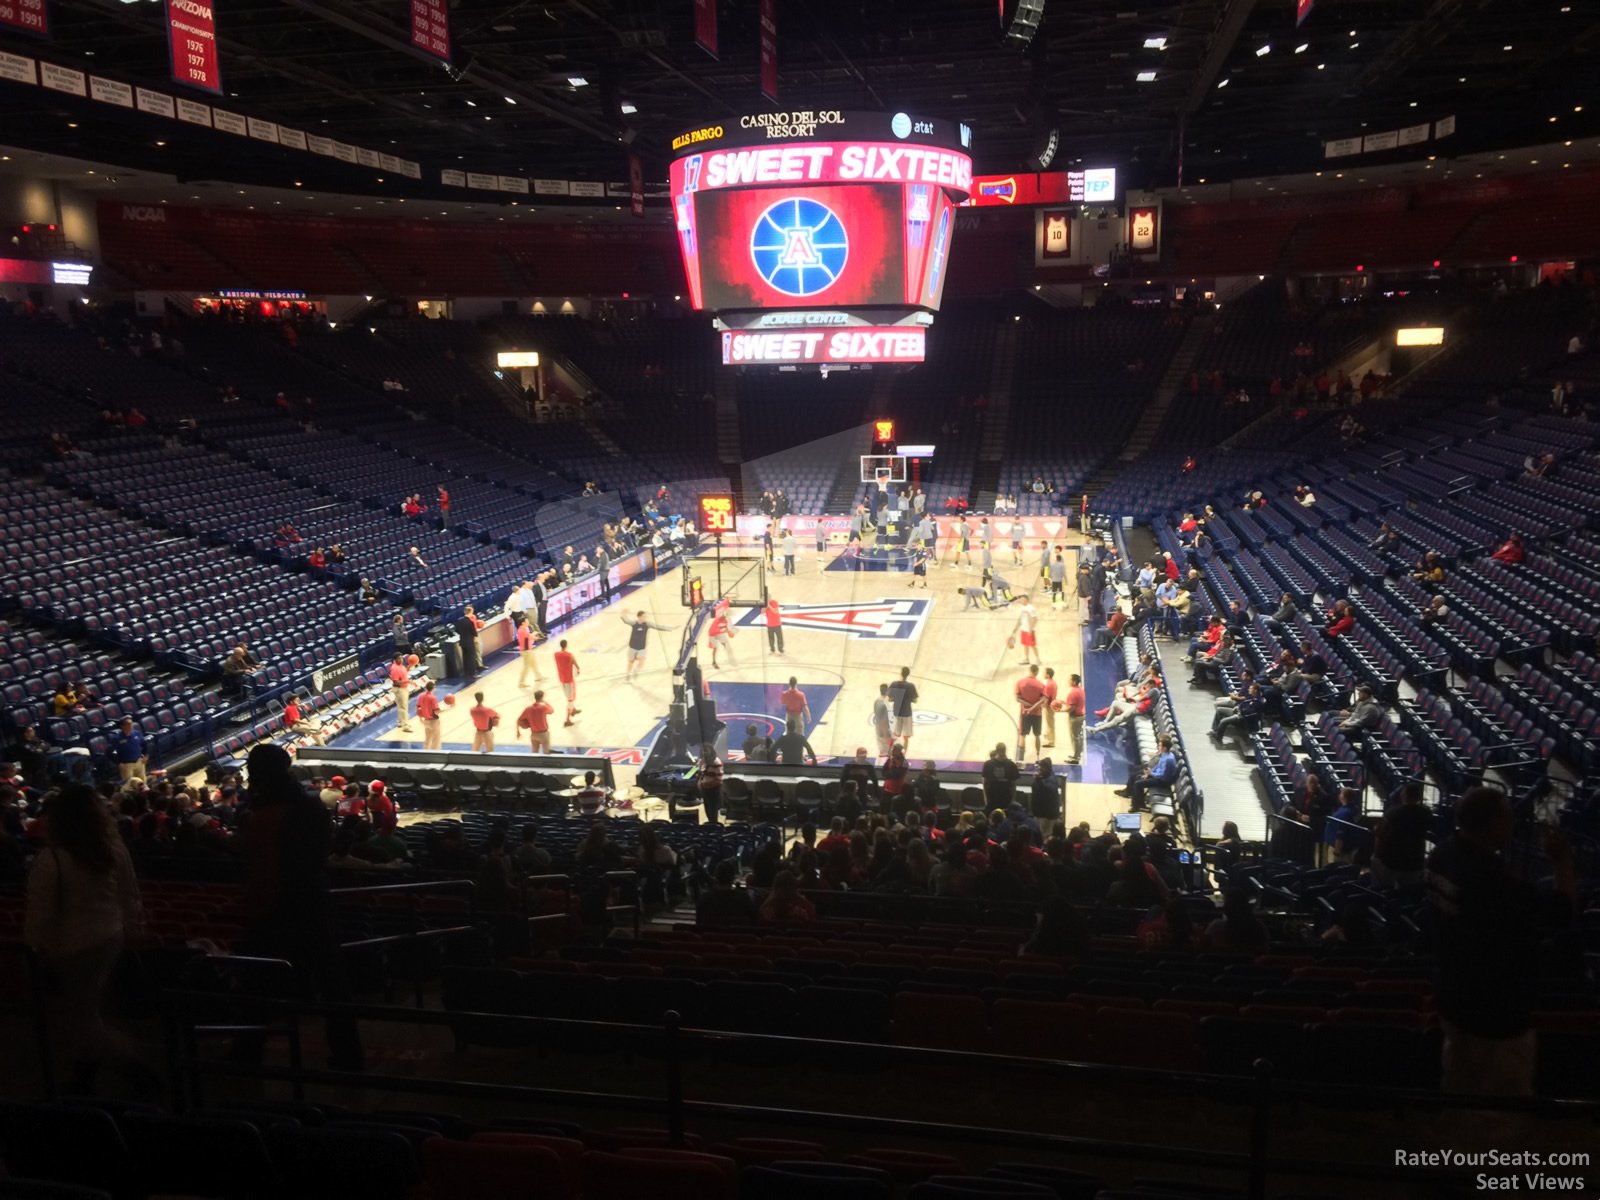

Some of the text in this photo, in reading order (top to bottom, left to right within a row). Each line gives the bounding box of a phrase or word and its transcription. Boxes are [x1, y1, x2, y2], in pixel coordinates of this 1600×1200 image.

[0, 5, 42, 27] 90 1991
[172, 0, 212, 21] ARIZONA
[186, 39, 204, 54] 1976
[188, 54, 205, 68] 1977
[189, 68, 207, 82] 1978
[740, 110, 845, 129] CASINO DEL SOL
[914, 120, 934, 135] at&t
[691, 126, 723, 143] FARGO
[766, 123, 817, 139] RESORT
[684, 154, 703, 193] 17
[707, 147, 833, 187] SWEET
[1086, 180, 1110, 192] TEP
[122, 205, 166, 223] NCAA
[1052, 230, 1062, 240] 10
[1137, 226, 1149, 236] 22
[805, 313, 849, 326] CENTER
[732, 331, 925, 360] SWEET SIXTEE
[707, 511, 728, 529] 30
[324, 660, 359, 681] NETWORKS
